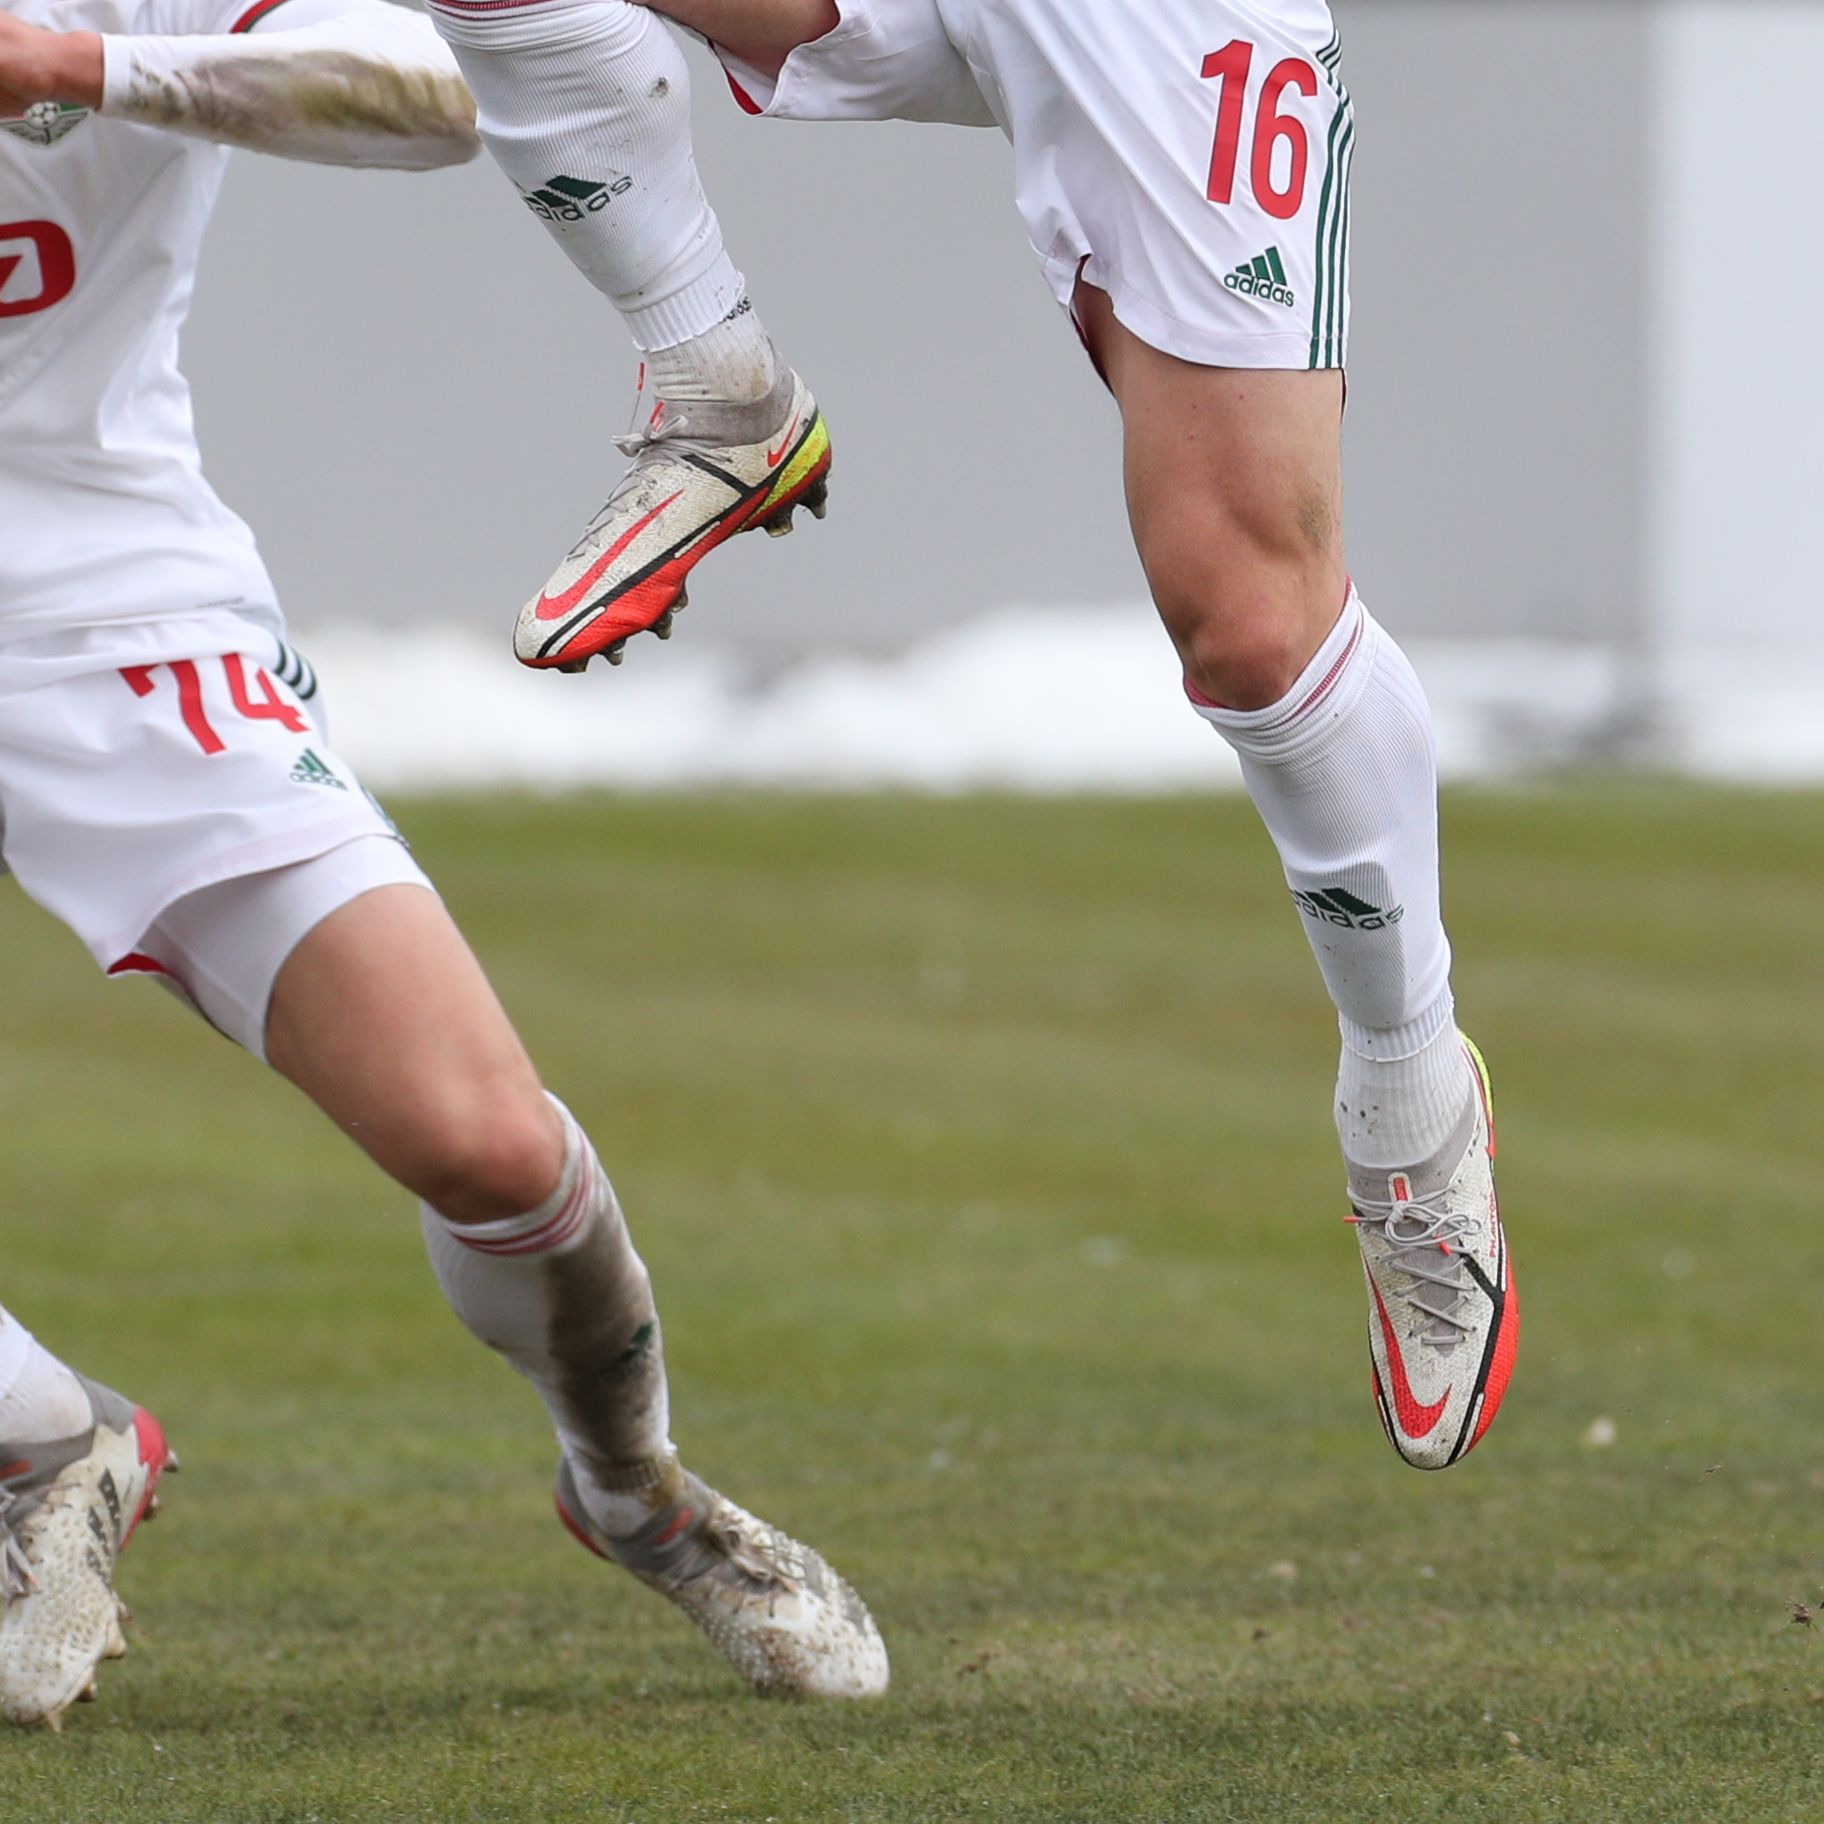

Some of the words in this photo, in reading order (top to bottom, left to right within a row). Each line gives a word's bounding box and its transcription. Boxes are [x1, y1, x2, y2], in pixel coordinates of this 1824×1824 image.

[1201, 39, 1318, 219] 16
[1224, 273, 1295, 308] adidas
[119, 652, 311, 756] 74
